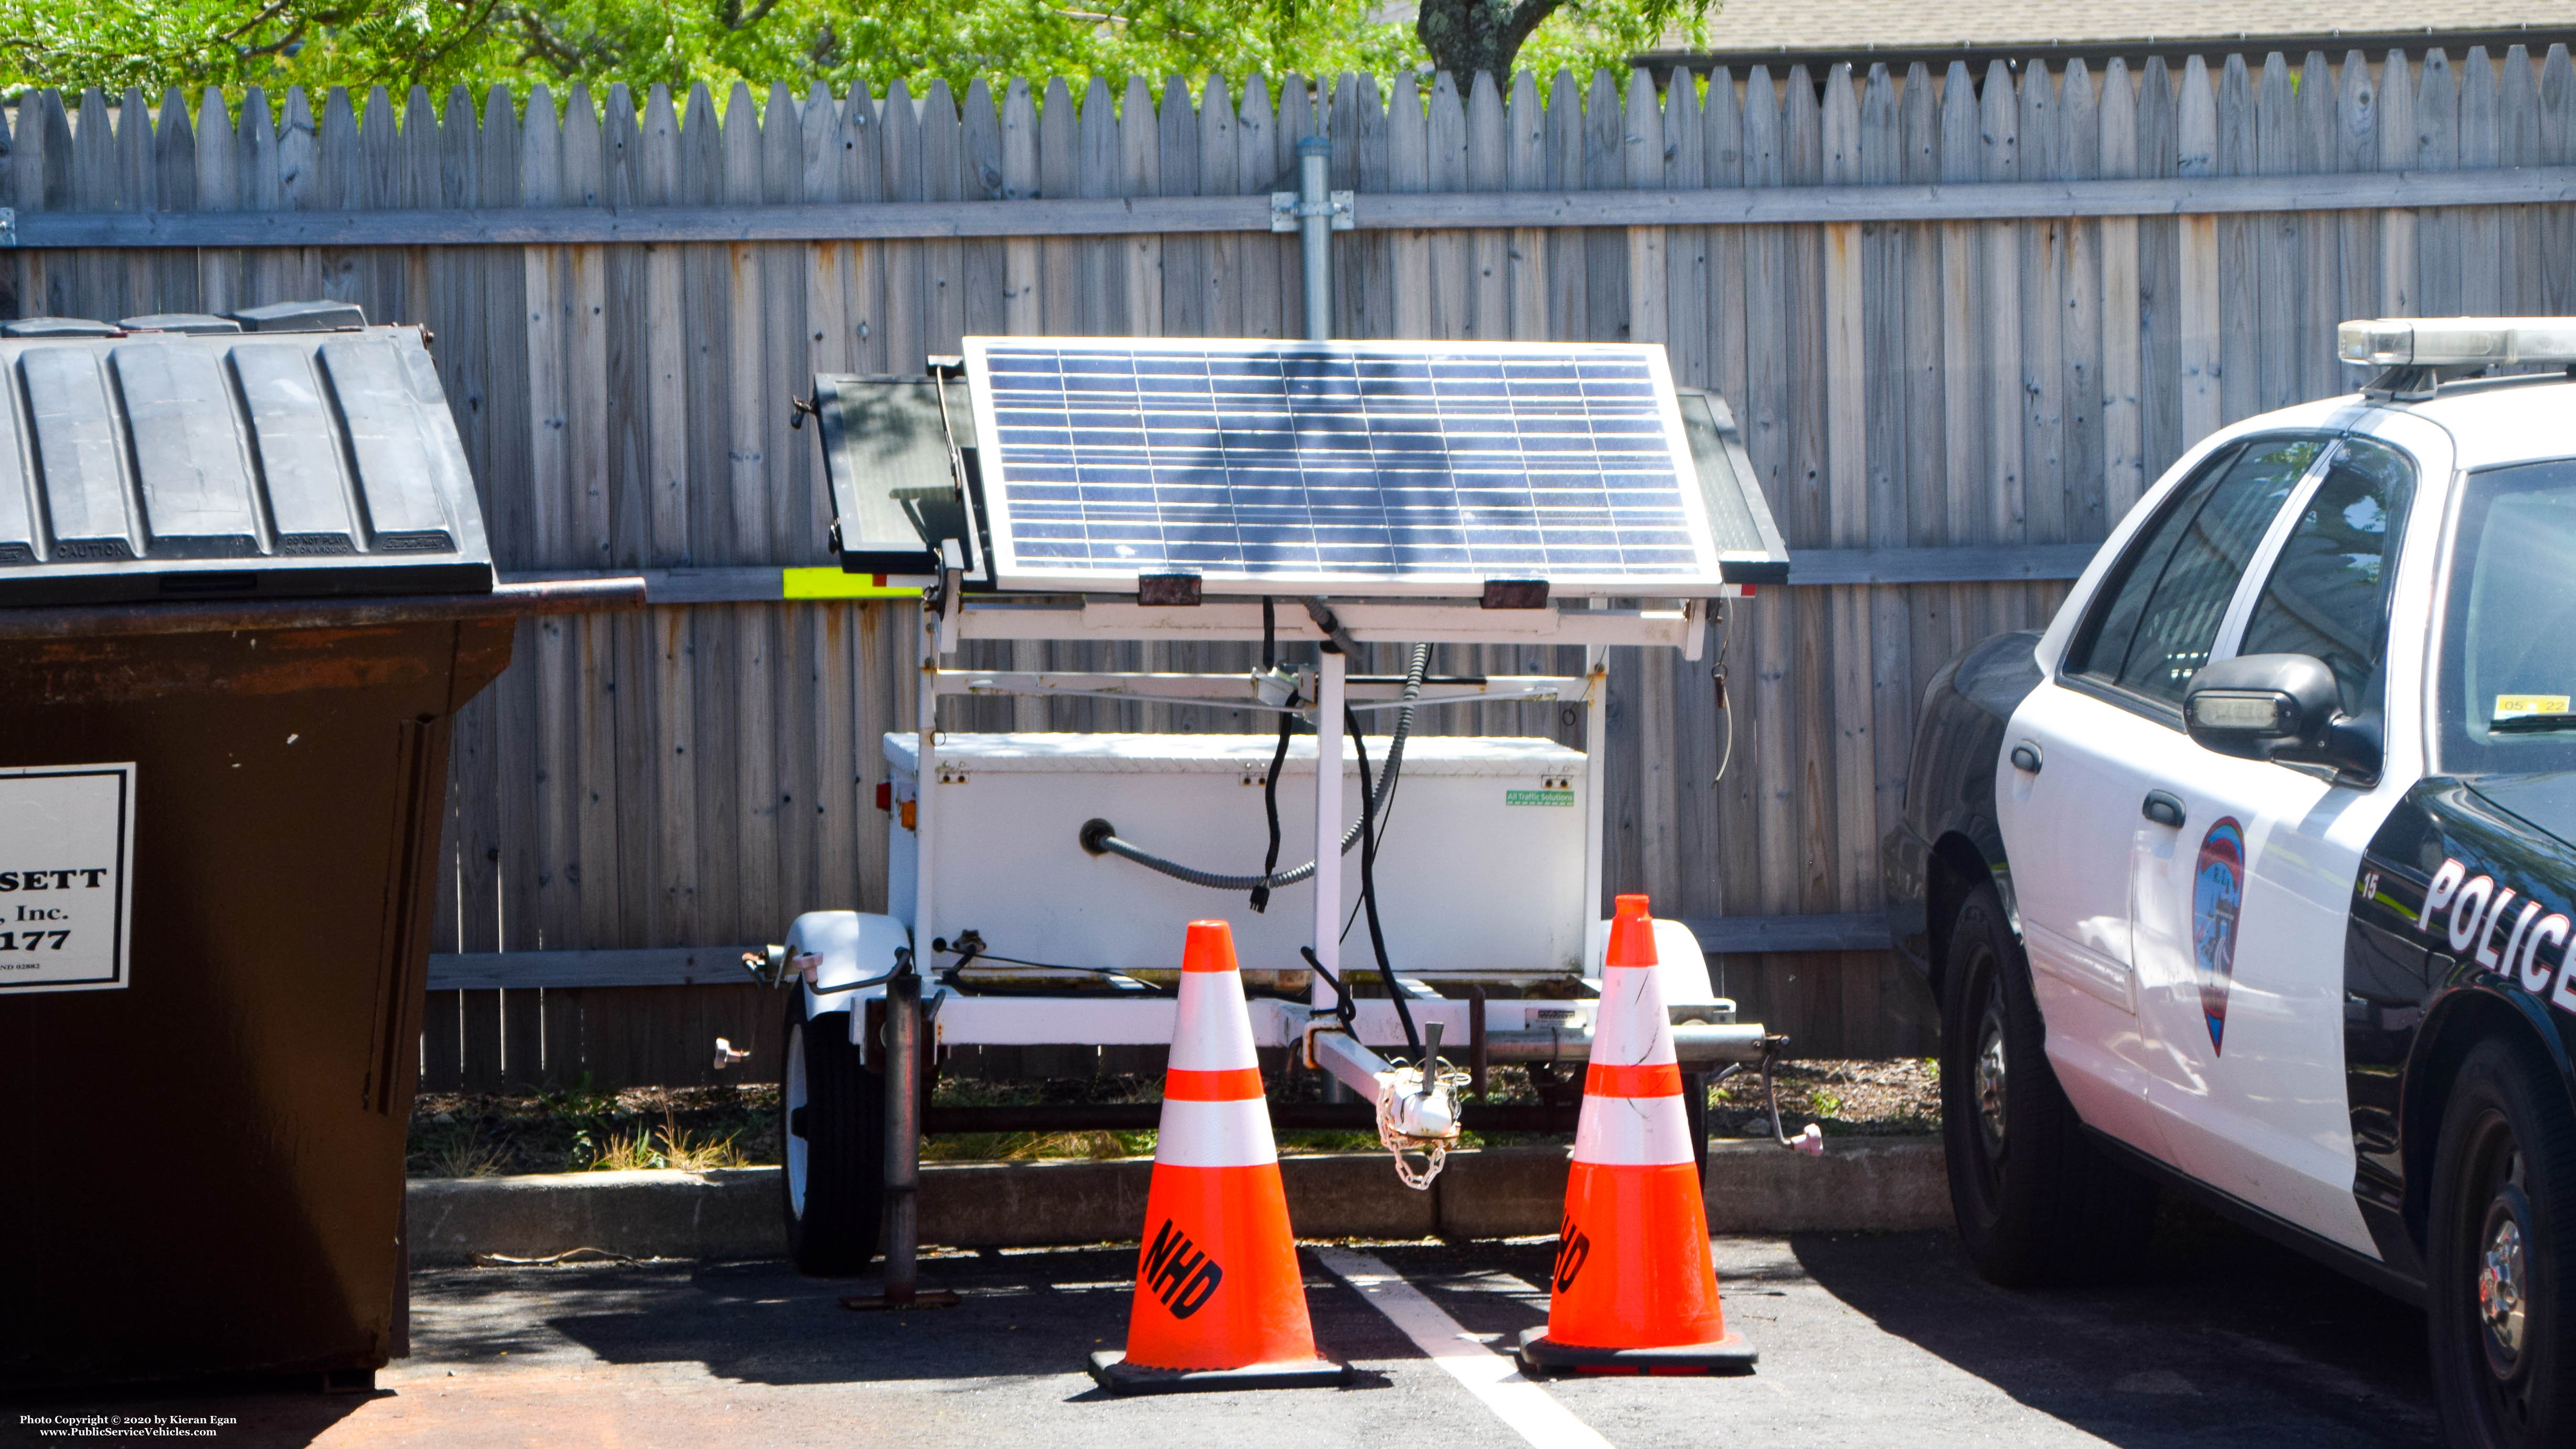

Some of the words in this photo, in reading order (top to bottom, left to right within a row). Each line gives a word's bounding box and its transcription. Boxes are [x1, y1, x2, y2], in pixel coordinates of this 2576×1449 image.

[302, 535, 320, 545] NOT
[58, 543, 127, 558] CAUTION
[2505, 701, 2524, 711] 05
[2545, 701, 2566, 711] 22
[1519, 792, 1540, 801] Traffic
[1541, 793, 1573, 802] Solutions
[0, 869, 107, 892] SETT
[2363, 871, 2380, 900] 15
[16, 904, 69, 922] Inc.
[1554, 1209, 1590, 1294] HD
[1142, 1218, 1223, 1319] NHD
